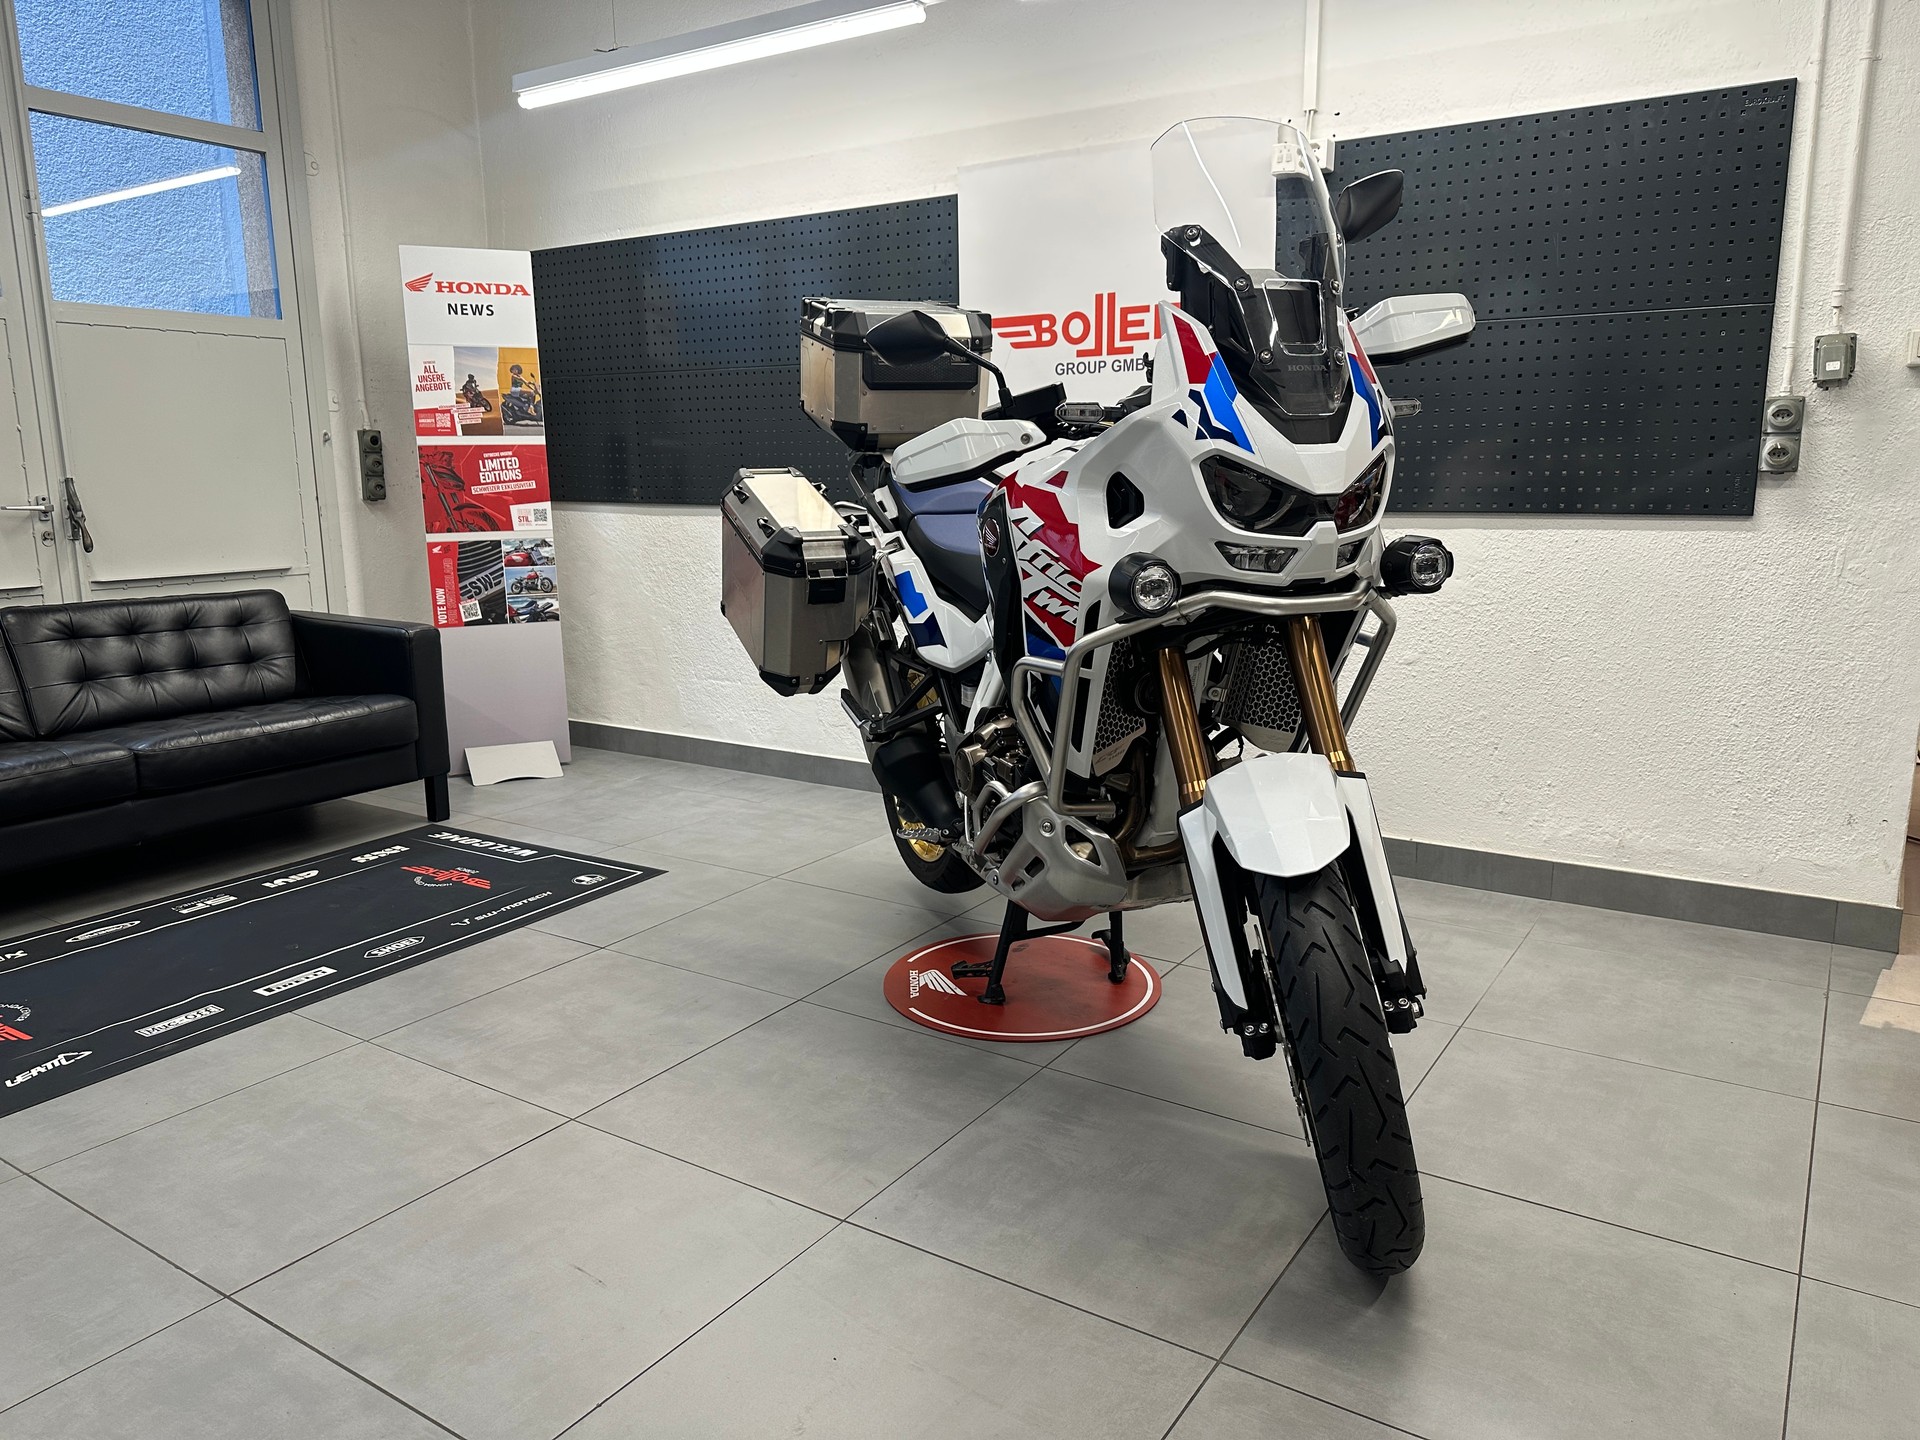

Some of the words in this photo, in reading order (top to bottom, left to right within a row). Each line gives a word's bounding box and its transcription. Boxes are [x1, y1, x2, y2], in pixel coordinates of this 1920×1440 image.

[434, 280, 531, 296] HONDA
[447, 303, 495, 316] NEWS
[423, 365, 438, 374] ALL
[1055, 360, 1107, 375] GROUP
[1111, 358, 1145, 372] GMB
[417, 374, 446, 383] UNSERE
[415, 382, 452, 392] ANGEBOTE
[479, 457, 519, 471] LIMITED
[479, 469, 522, 483] EDITIONS
[435, 588, 446, 605] NOW
[436, 606, 448, 625] VOTE
[428, 831, 538, 857] WELCOME
[261, 869, 319, 888] GIVI
[371, 938, 417, 956] SHOEI
[909, 969, 919, 998] HONDA
